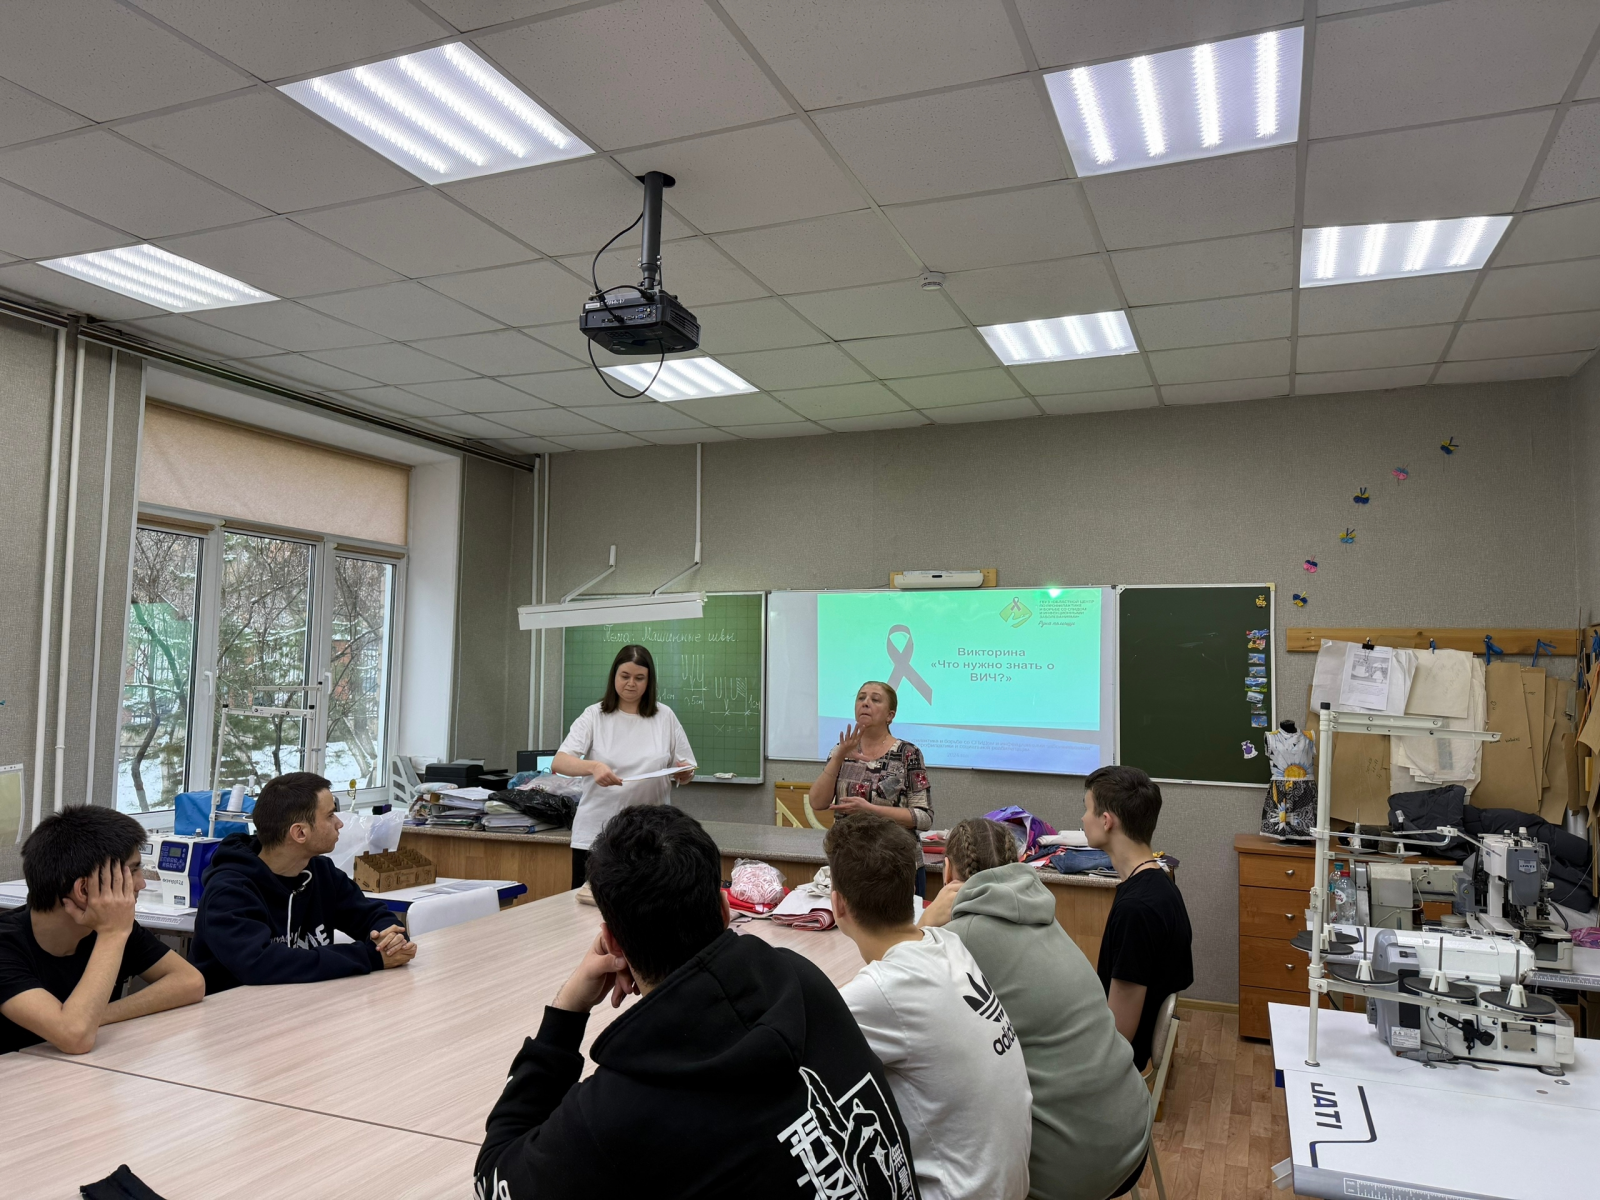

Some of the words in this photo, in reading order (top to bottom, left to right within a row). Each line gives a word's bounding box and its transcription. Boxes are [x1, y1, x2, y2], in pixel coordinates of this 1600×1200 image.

[957, 647, 1026, 658] Викторина
[930, 659, 960, 669] «Что
[963, 661, 1003, 671] нужно
[1006, 662, 1043, 670] знать
[1046, 662, 1055, 670] о
[970, 672, 1012, 682] ВИЧ?»
[1310, 1082, 1343, 1130] JATI
